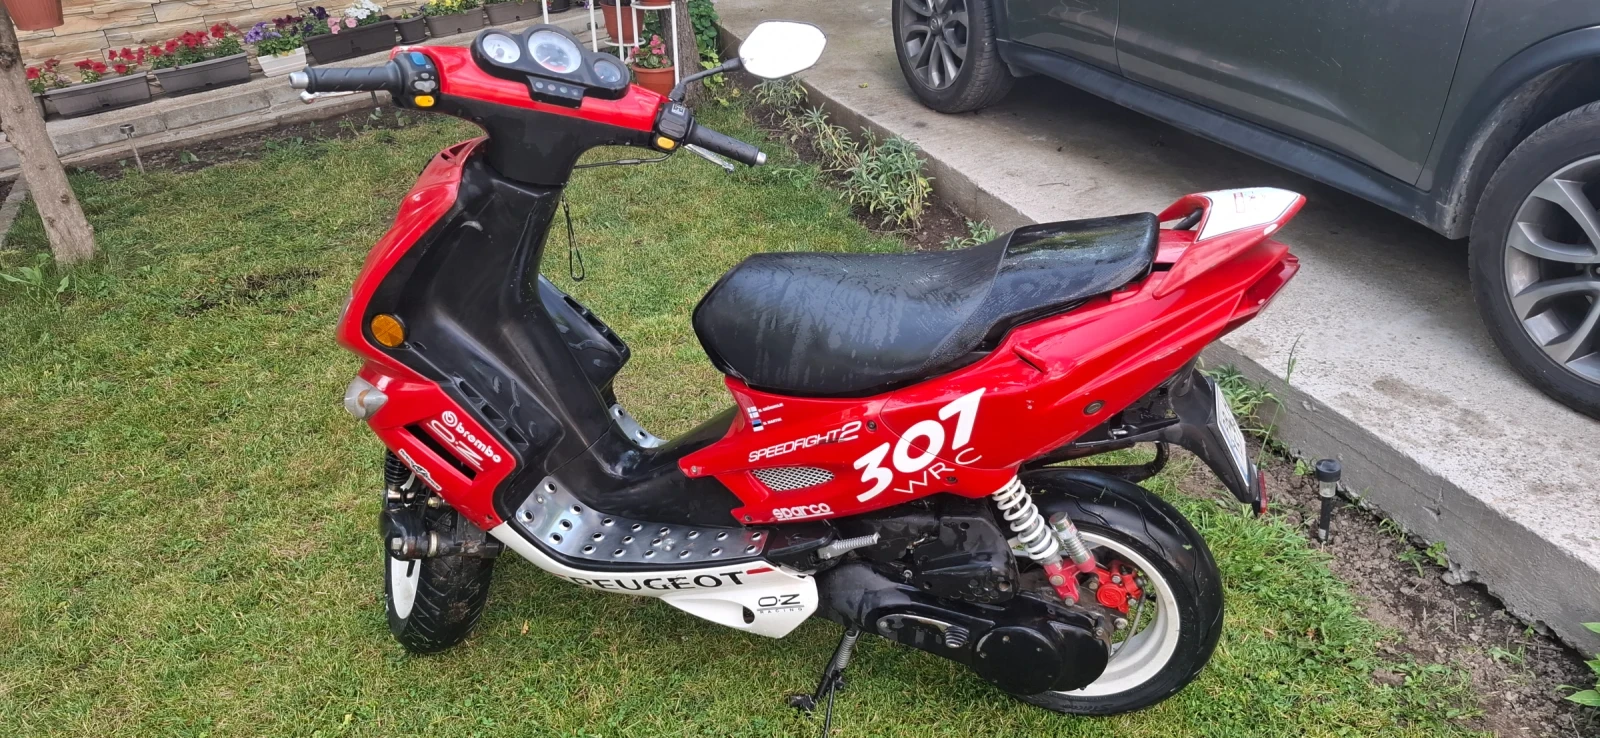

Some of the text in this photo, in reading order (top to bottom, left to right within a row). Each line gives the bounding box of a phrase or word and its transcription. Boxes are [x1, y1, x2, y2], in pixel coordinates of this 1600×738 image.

[854, 387, 986, 503] 307
[772, 503, 832, 520] sparco
[569, 570, 745, 591] PEUGEOT
